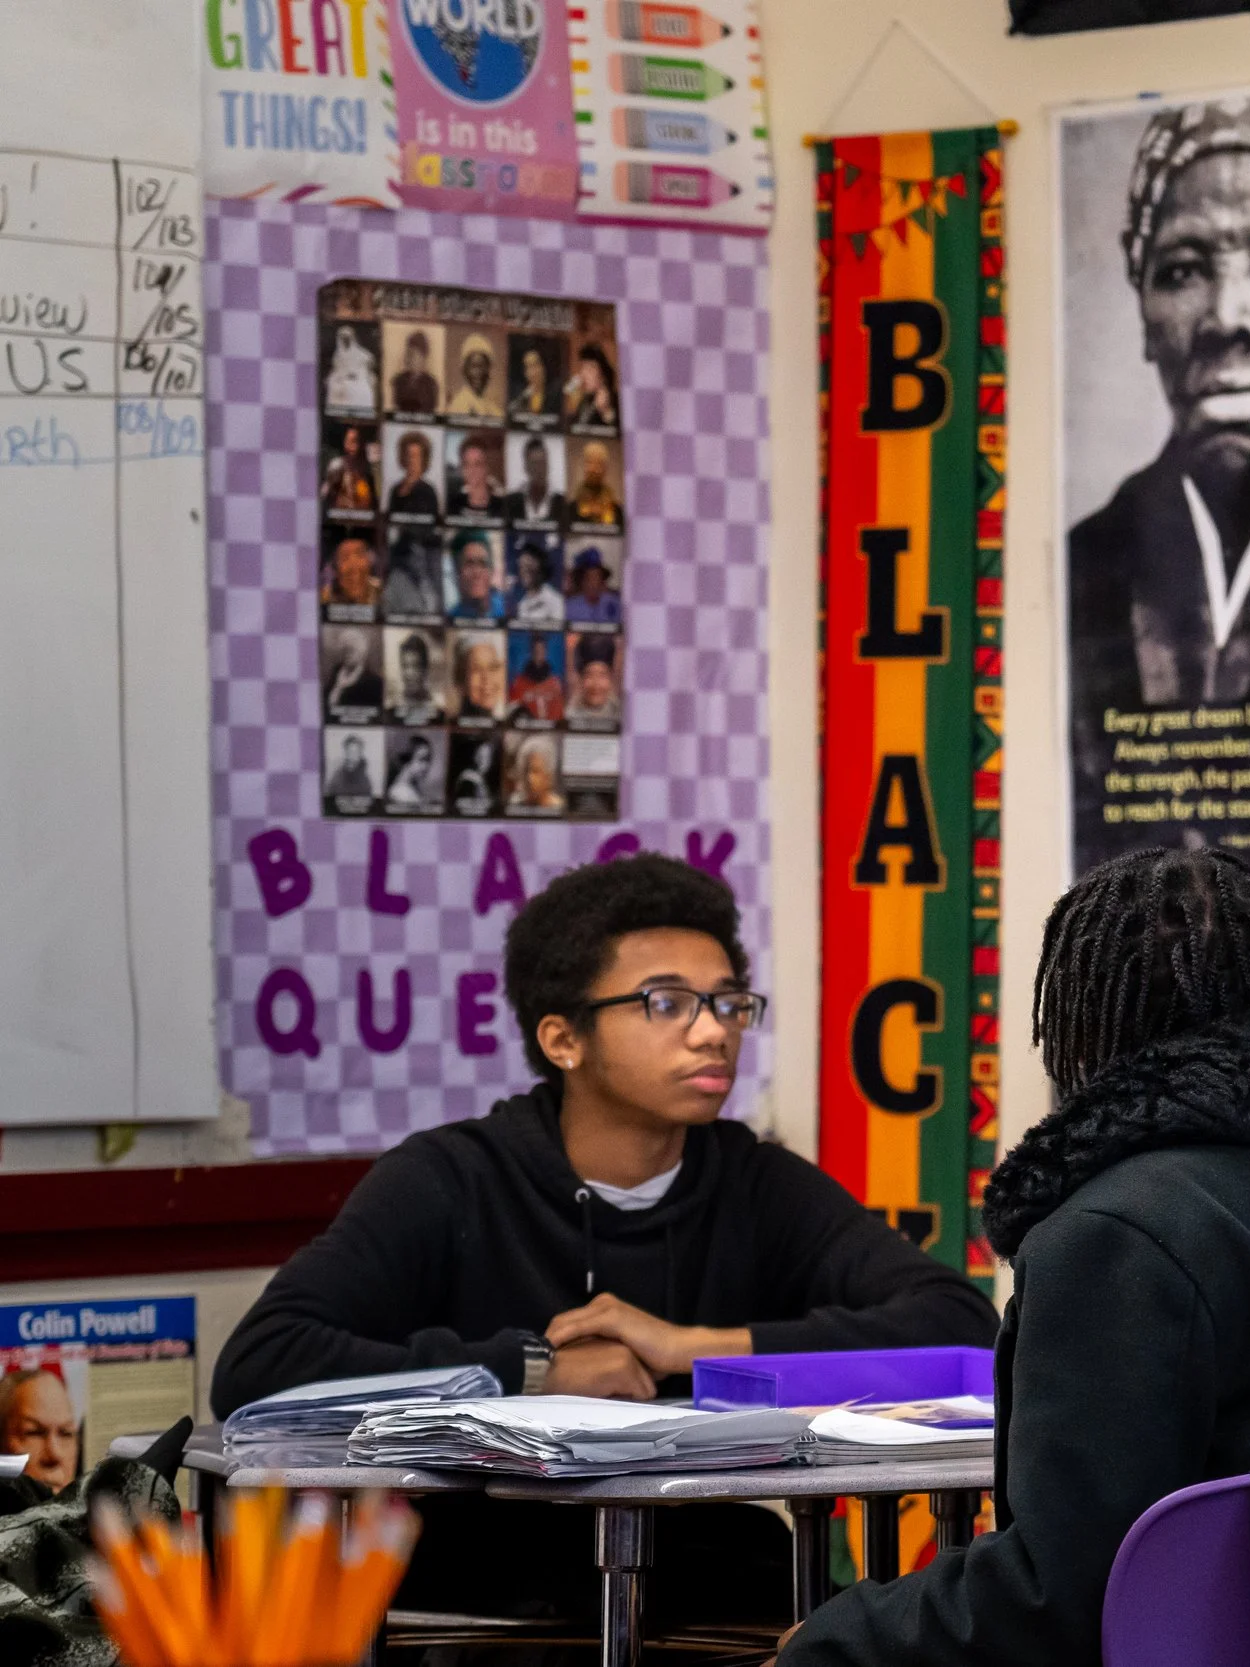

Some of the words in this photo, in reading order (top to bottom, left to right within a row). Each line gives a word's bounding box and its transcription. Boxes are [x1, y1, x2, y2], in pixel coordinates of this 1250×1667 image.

[204, 0, 368, 78] GREAT
[400, 0, 543, 38] WORLD
[219, 90, 368, 154] THINGS!
[415, 109, 442, 146] is
[448, 113, 477, 149] in
[482, 119, 537, 156] this
[403, 139, 577, 197] lassroom
[1104, 707, 1149, 737] Every
[1150, 710, 1192, 737] great
[1193, 705, 1245, 729] dream
[853, 299, 949, 1246] BLAC
[1114, 738, 1170, 766] Always
[1105, 769, 1134, 793] the
[1202, 765, 1230, 790] the
[1103, 803, 1124, 824] to
[1124, 797, 1170, 823] reach
[1170, 796, 1196, 821] for
[1197, 796, 1227, 821] the
[255, 966, 498, 1060] QUE
[18, 1310, 76, 1340] Colin
[80, 1304, 156, 1337] Powell
